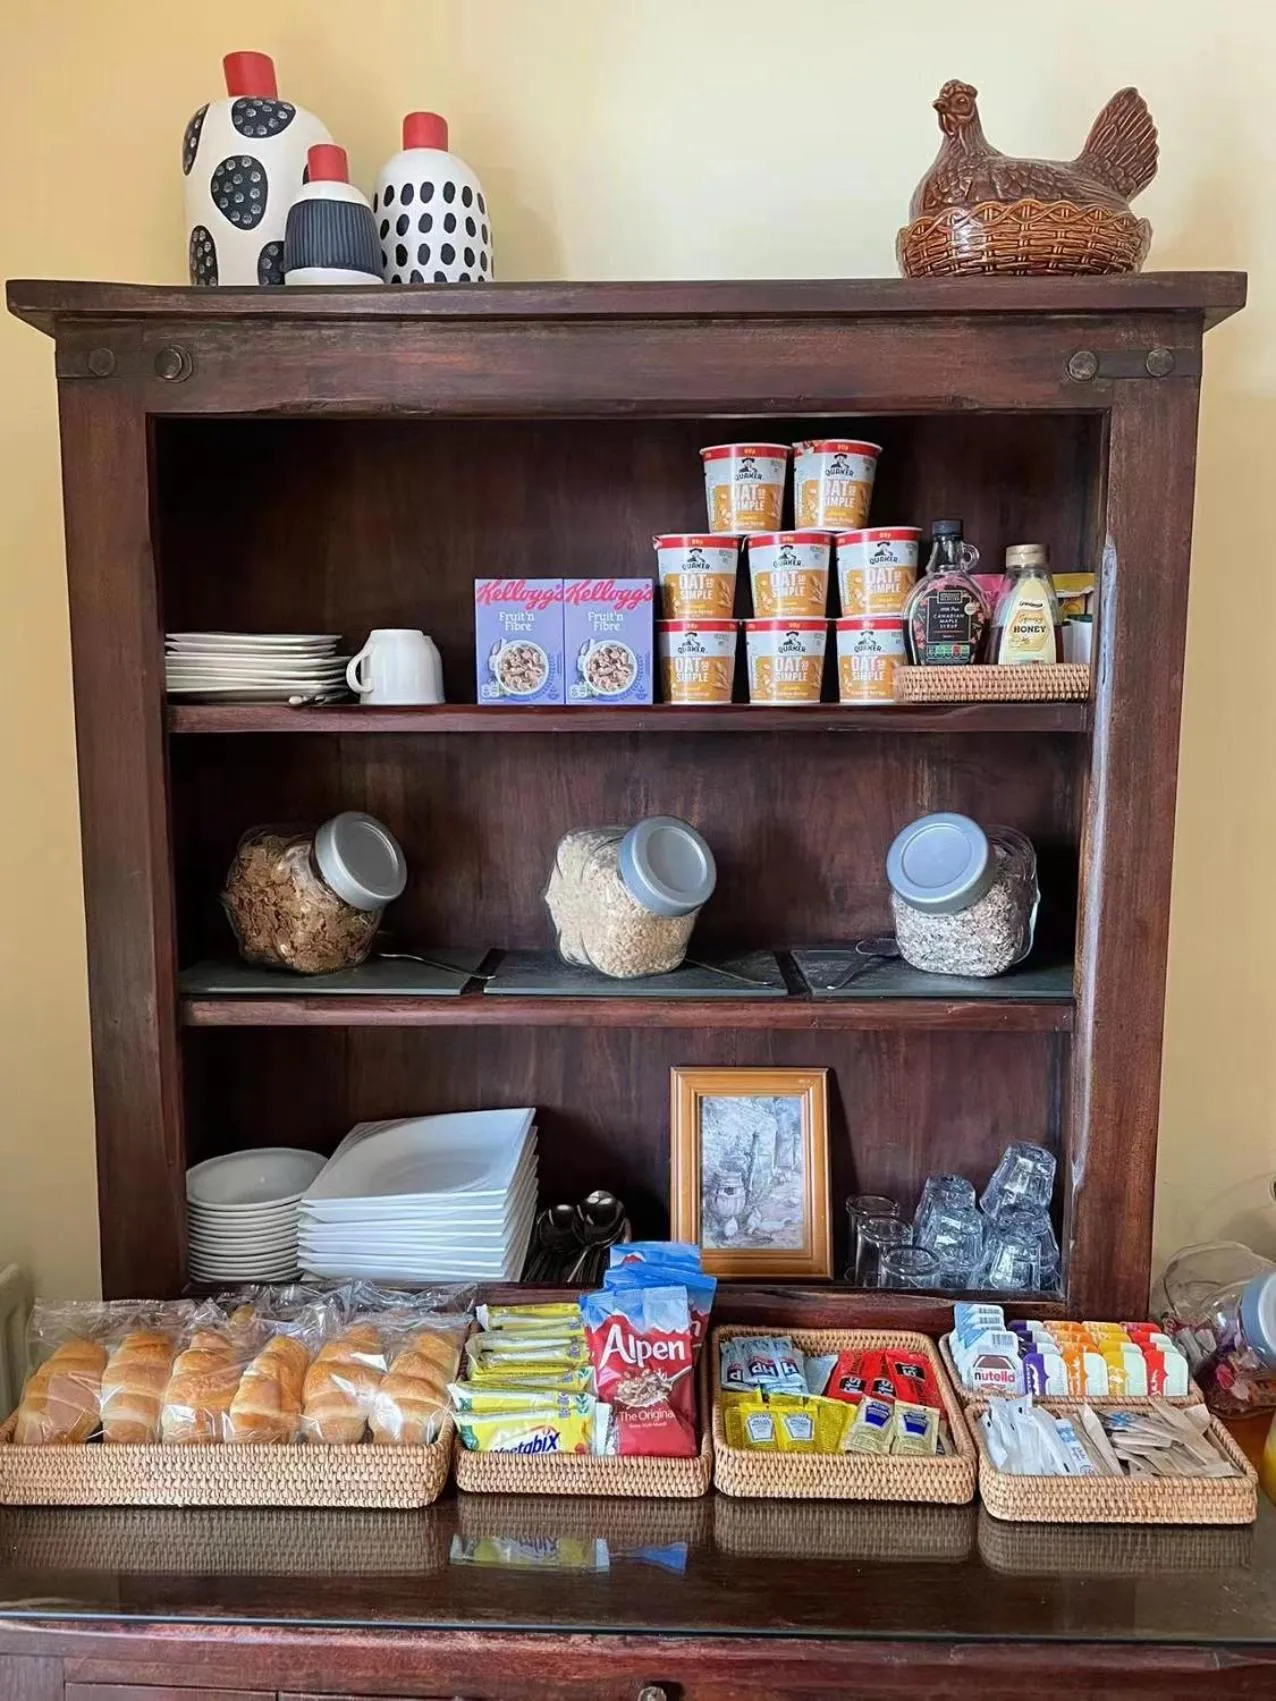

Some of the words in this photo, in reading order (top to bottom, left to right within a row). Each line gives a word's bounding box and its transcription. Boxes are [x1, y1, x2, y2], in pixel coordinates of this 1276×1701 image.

[825, 468, 854, 477] QUAKER
[869, 556, 898, 565] QUAKER
[681, 562, 711, 571] QUAKER
[866, 567, 894, 583] OAT
[679, 574, 707, 590] OAT
[477, 580, 564, 611] Kellogg's
[565, 579, 653, 611] Kellogg's
[679, 590, 713, 600] SIMPLE
[505, 621, 532, 632] Fibre
[593, 621, 621, 632] Fibre
[1013, 625, 1047, 634] HONEY
[677, 646, 706, 654] QUAKER
[778, 645, 806, 654] QUAKER
[853, 645, 882, 653] QUAKER
[598, 1323, 685, 1369] Alpen
[751, 1362, 775, 1376] HP
[974, 1371, 1016, 1383] nutella
[620, 1411, 638, 1422] The
[638, 1408, 676, 1422] Origina
[490, 1428, 561, 1454] etabix
